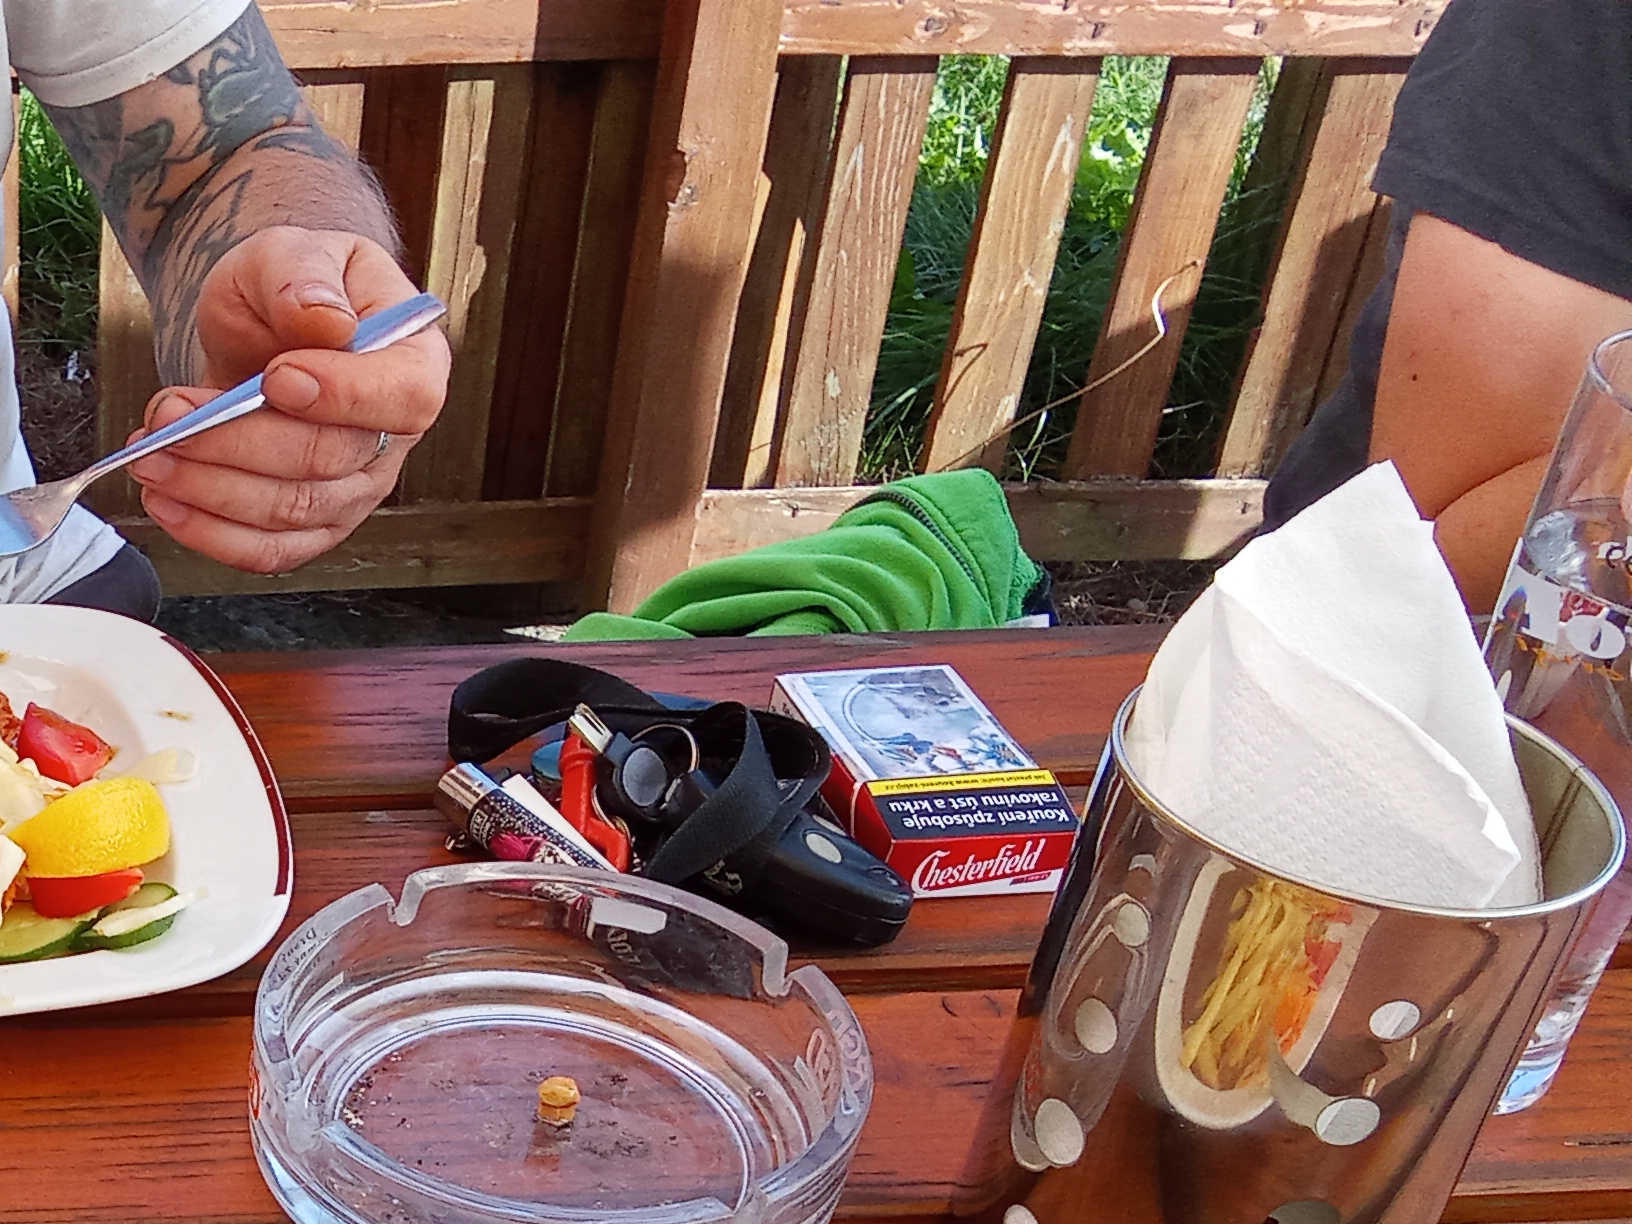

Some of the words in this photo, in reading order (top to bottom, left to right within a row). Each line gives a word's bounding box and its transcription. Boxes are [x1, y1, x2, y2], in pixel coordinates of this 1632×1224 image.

[888, 799, 934, 814] krku
[933, 798, 947, 809] a
[948, 796, 979, 810] úst
[980, 791, 1060, 808] rakovinu
[902, 810, 996, 830] způsobuje
[997, 808, 1070, 826] Kouření
[911, 838, 1046, 895] Chesterfield
